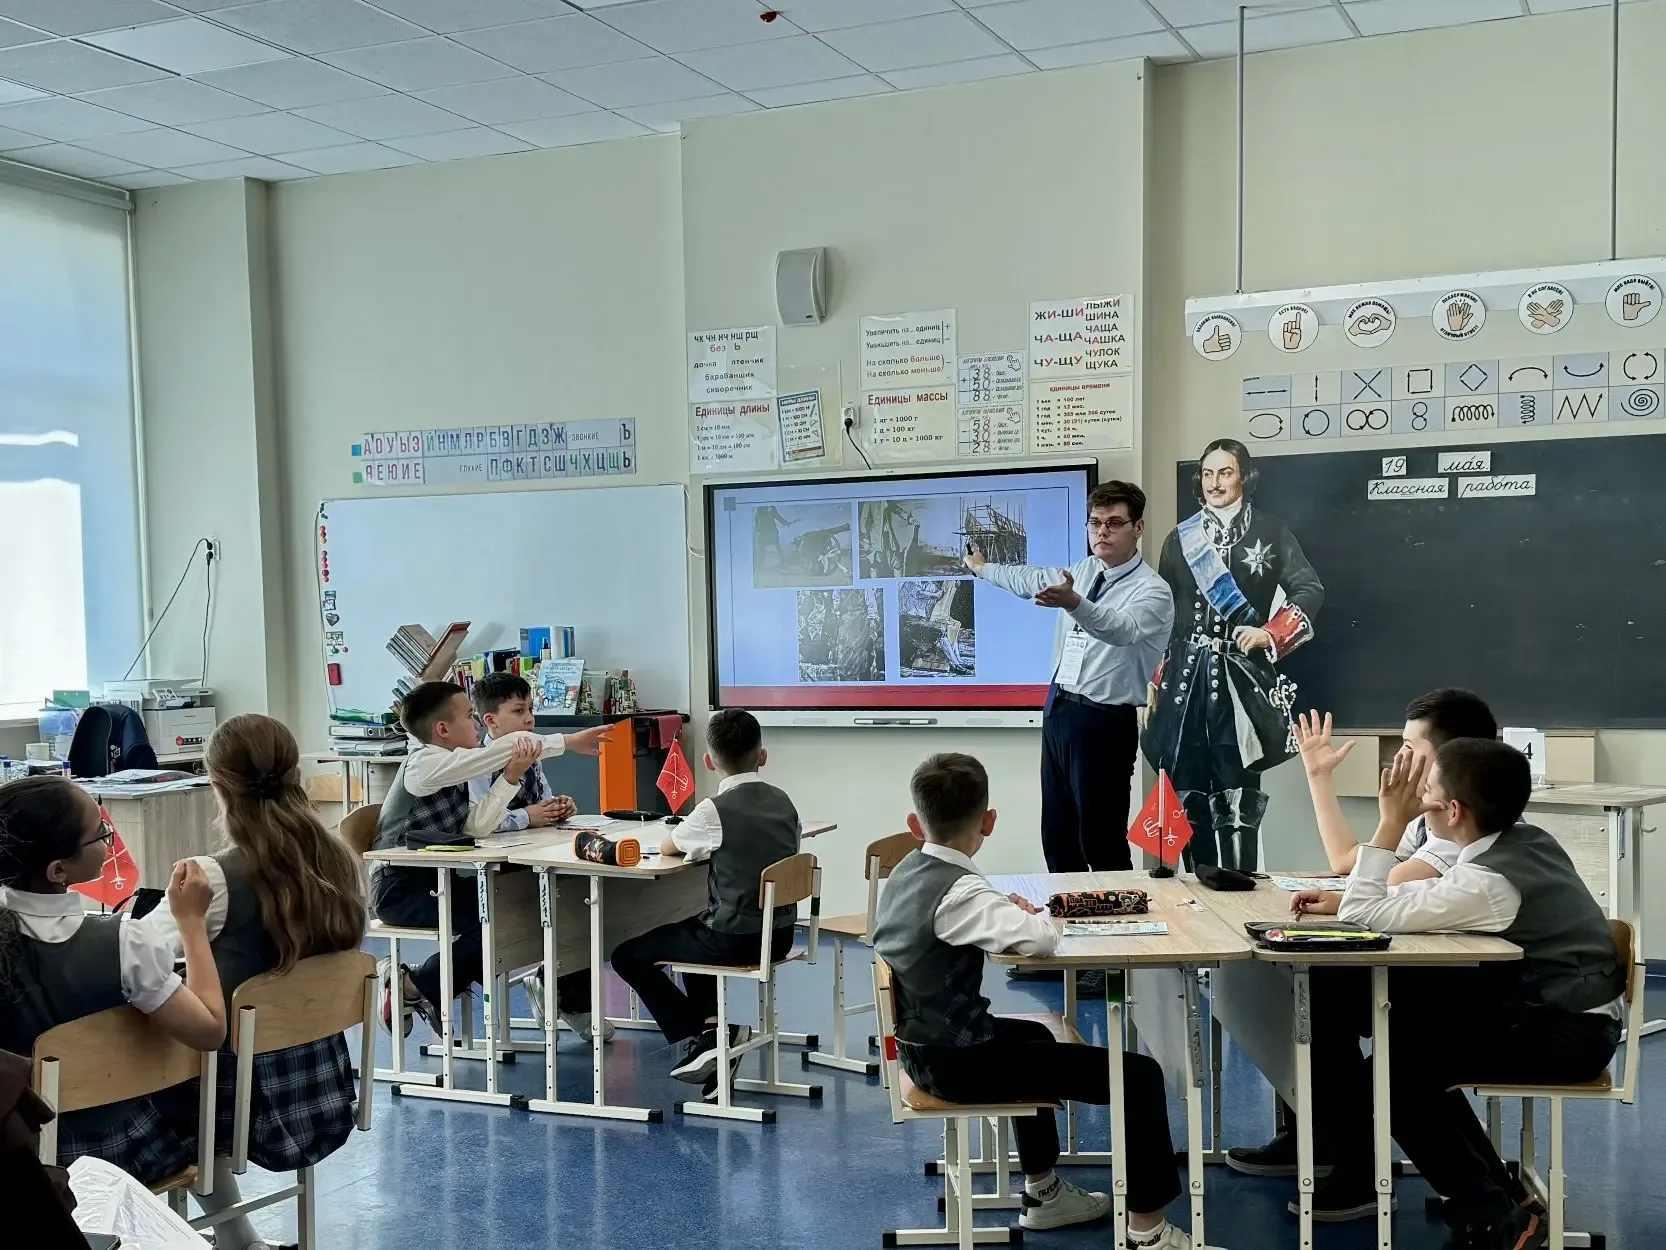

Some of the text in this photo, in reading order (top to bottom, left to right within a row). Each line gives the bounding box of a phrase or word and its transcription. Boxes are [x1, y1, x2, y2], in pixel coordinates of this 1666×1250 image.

[1085, 299, 1120, 309] ЛЫЖИ
[1034, 308, 1084, 321] ЖИ-ШИ
[1085, 311, 1119, 321] ШИНА
[1085, 323, 1118, 333] ЧАЩА
[746, 331, 759, 342] рщ
[1034, 332, 1083, 343] ЧА-ЩА
[1084, 335, 1125, 344] ЧАШКА
[710, 343, 726, 352] без
[1085, 348, 1120, 357] ЧУЛОК
[878, 358, 908, 366] сколько
[1034, 356, 1083, 367] ЧУ-ЩУ
[1085, 360, 1118, 370] ЩУКА
[705, 372, 755, 381] барабанщик
[879, 369, 909, 377] сколько
[868, 392, 948, 406] Единицы массы
[695, 404, 770, 419] Единицы длины
[572, 432, 599, 441] ЗВОНКИЕ
[1385, 458, 1406, 474] 19
[1369, 481, 1446, 495] Классная
